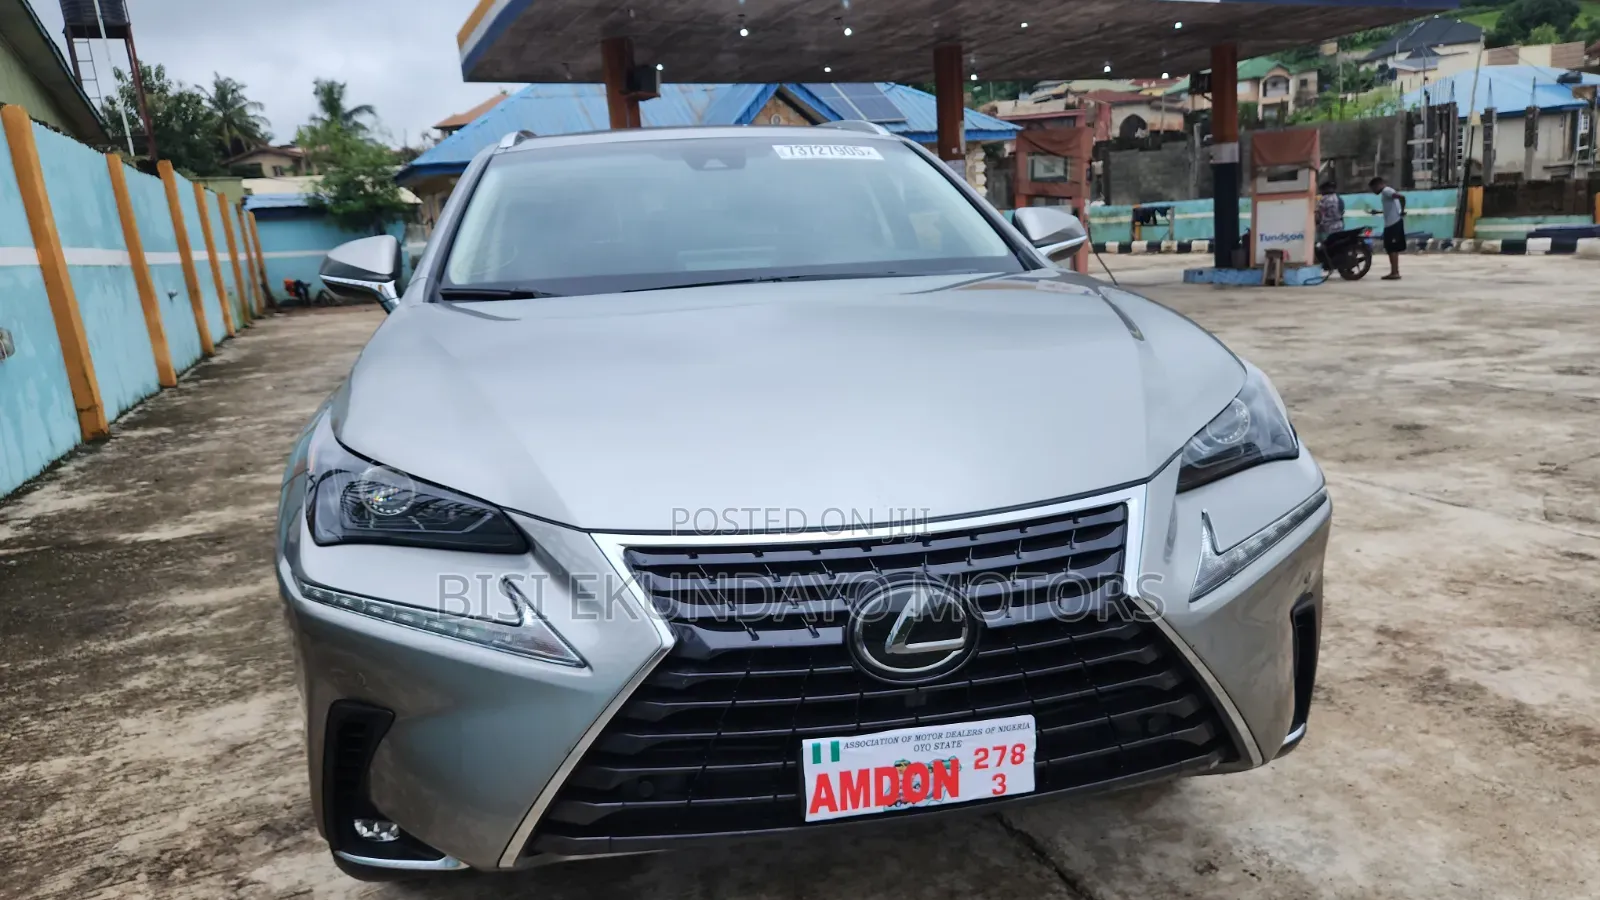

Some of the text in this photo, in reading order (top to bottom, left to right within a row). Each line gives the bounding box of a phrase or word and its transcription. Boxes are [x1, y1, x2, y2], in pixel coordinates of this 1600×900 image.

[844, 722, 1030, 749] ASSOCIATION OF MOTOR DEALERS OF NIGERIA
[913, 740, 963, 752] OYO STATE
[973, 743, 1026, 770] 278
[809, 758, 959, 814] AMDON
[991, 773, 1007, 796] 3
